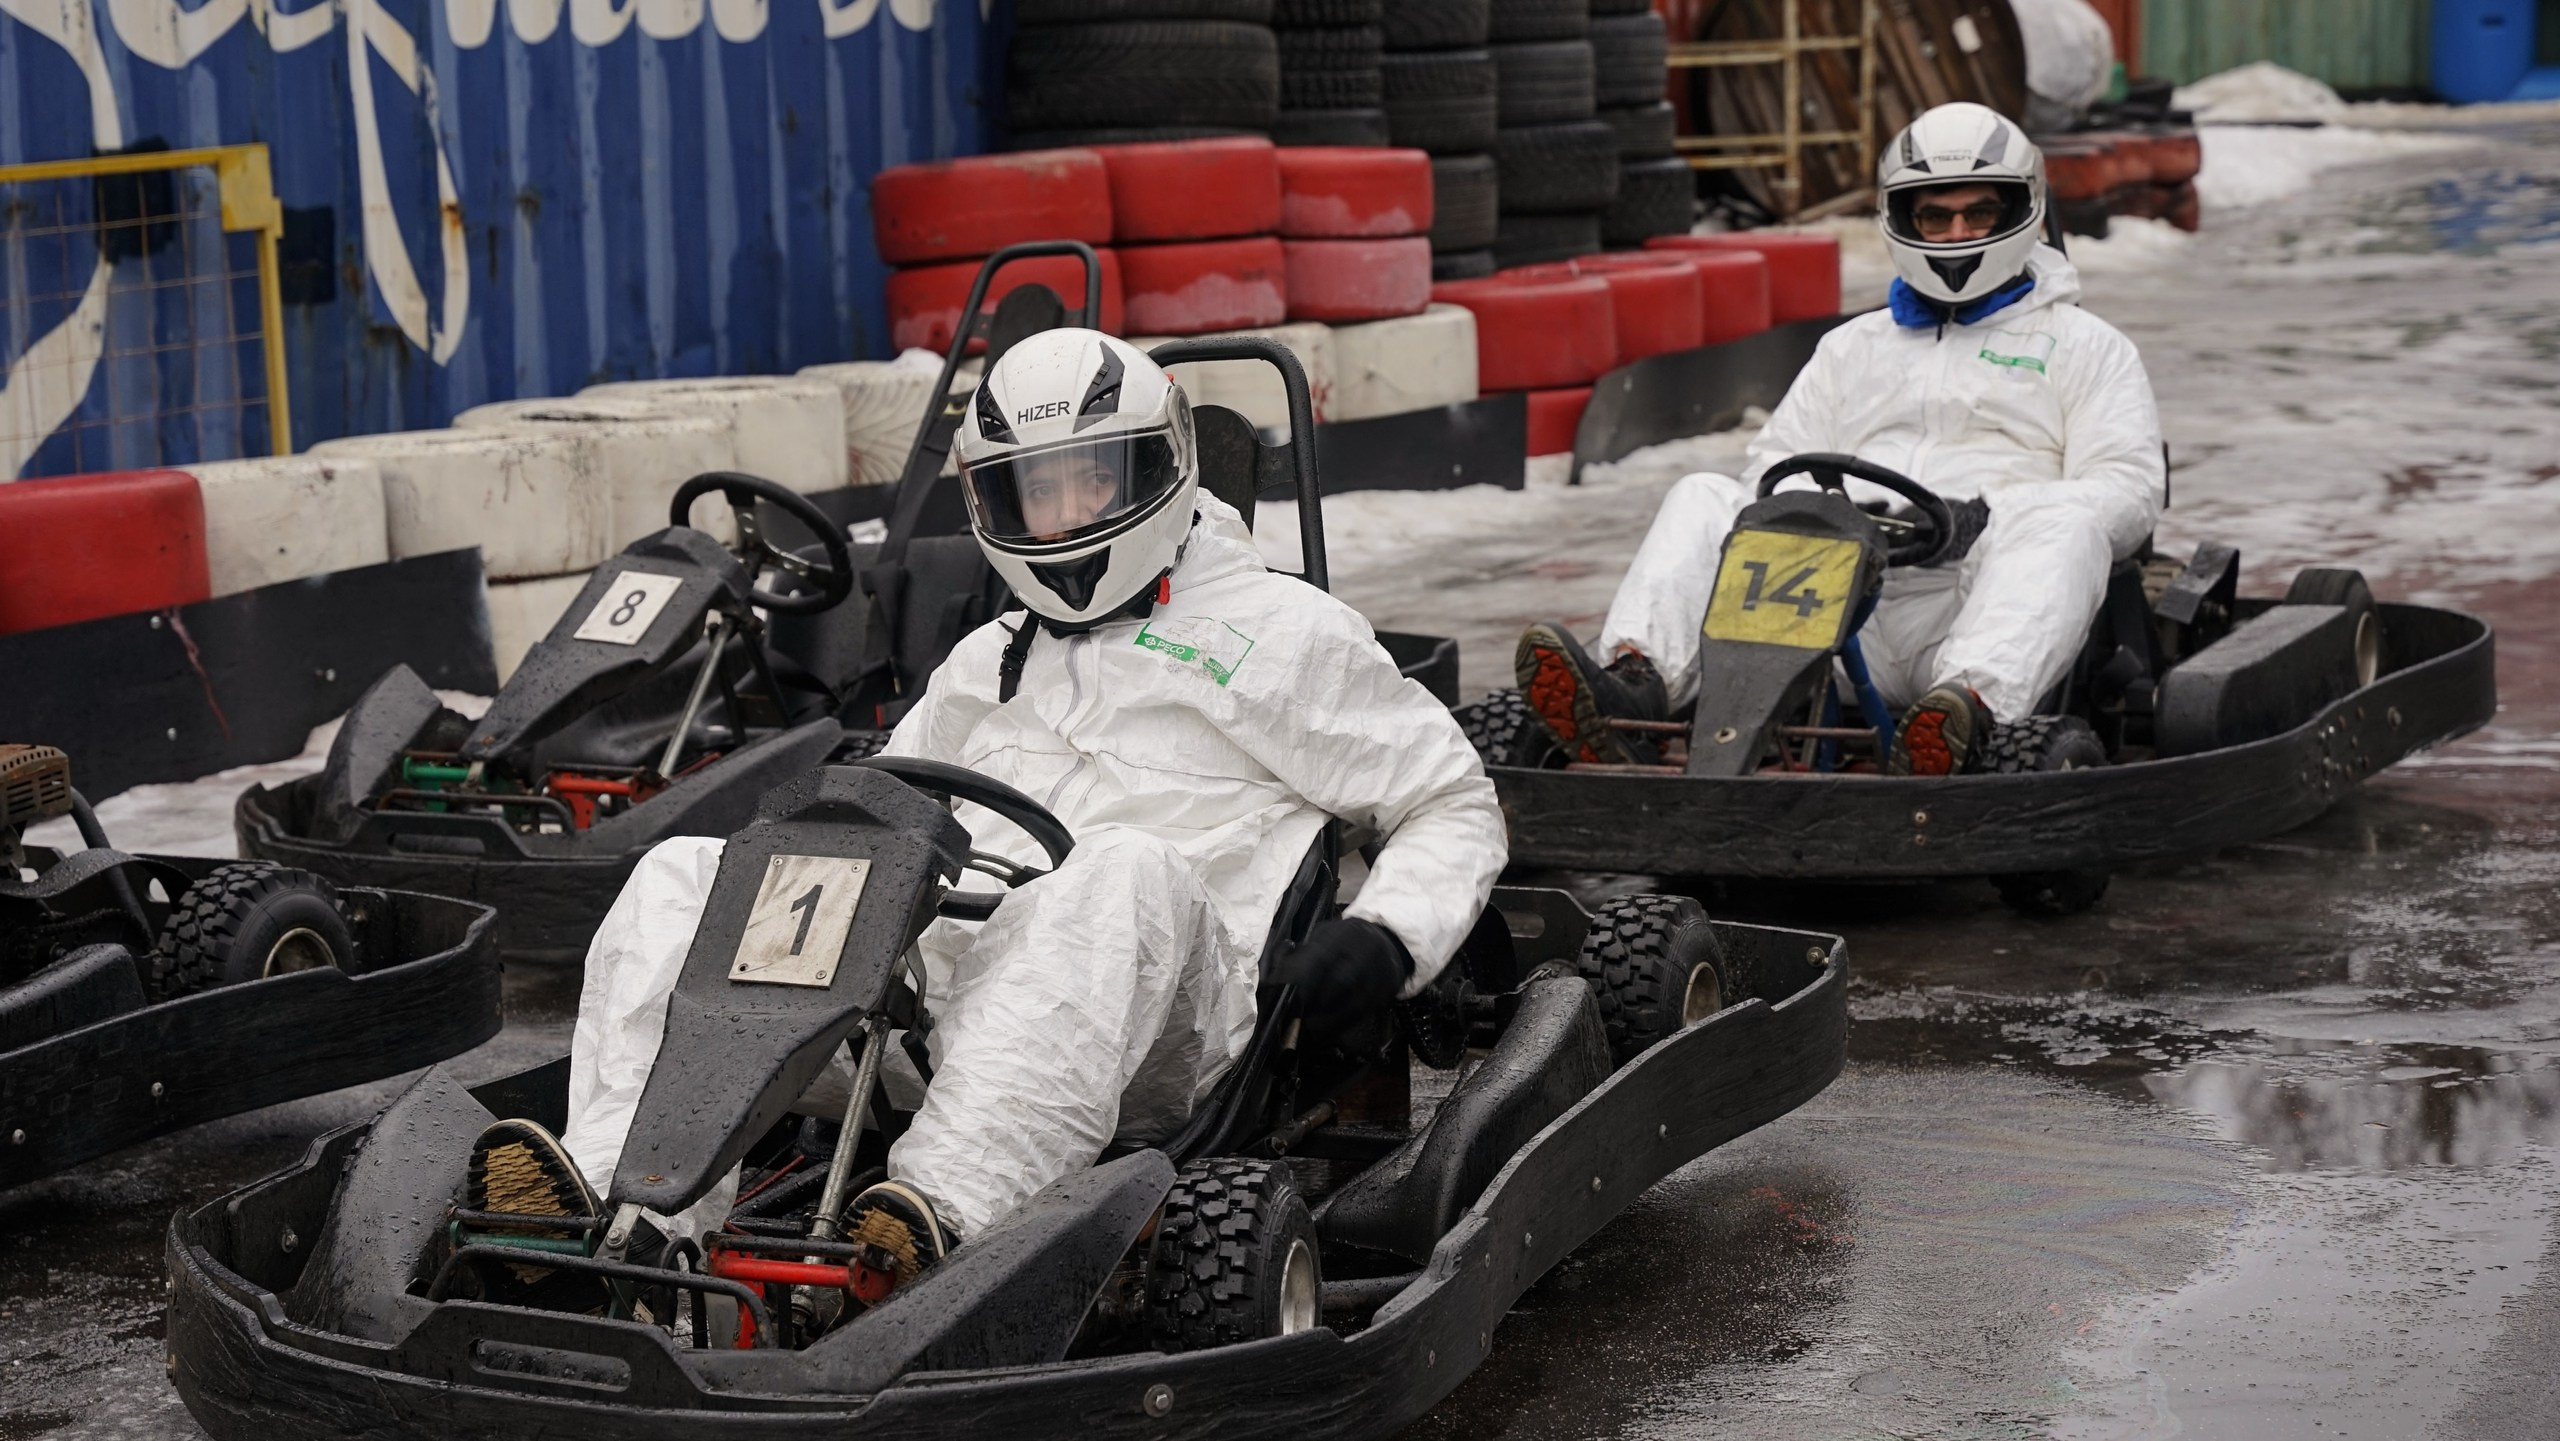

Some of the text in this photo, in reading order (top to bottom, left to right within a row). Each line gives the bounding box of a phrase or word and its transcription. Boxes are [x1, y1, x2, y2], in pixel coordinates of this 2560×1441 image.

[1017, 400, 1071, 425] HIZER
[608, 589, 647, 627] 8
[1741, 560, 1825, 618] 14
[789, 884, 824, 956] 1
